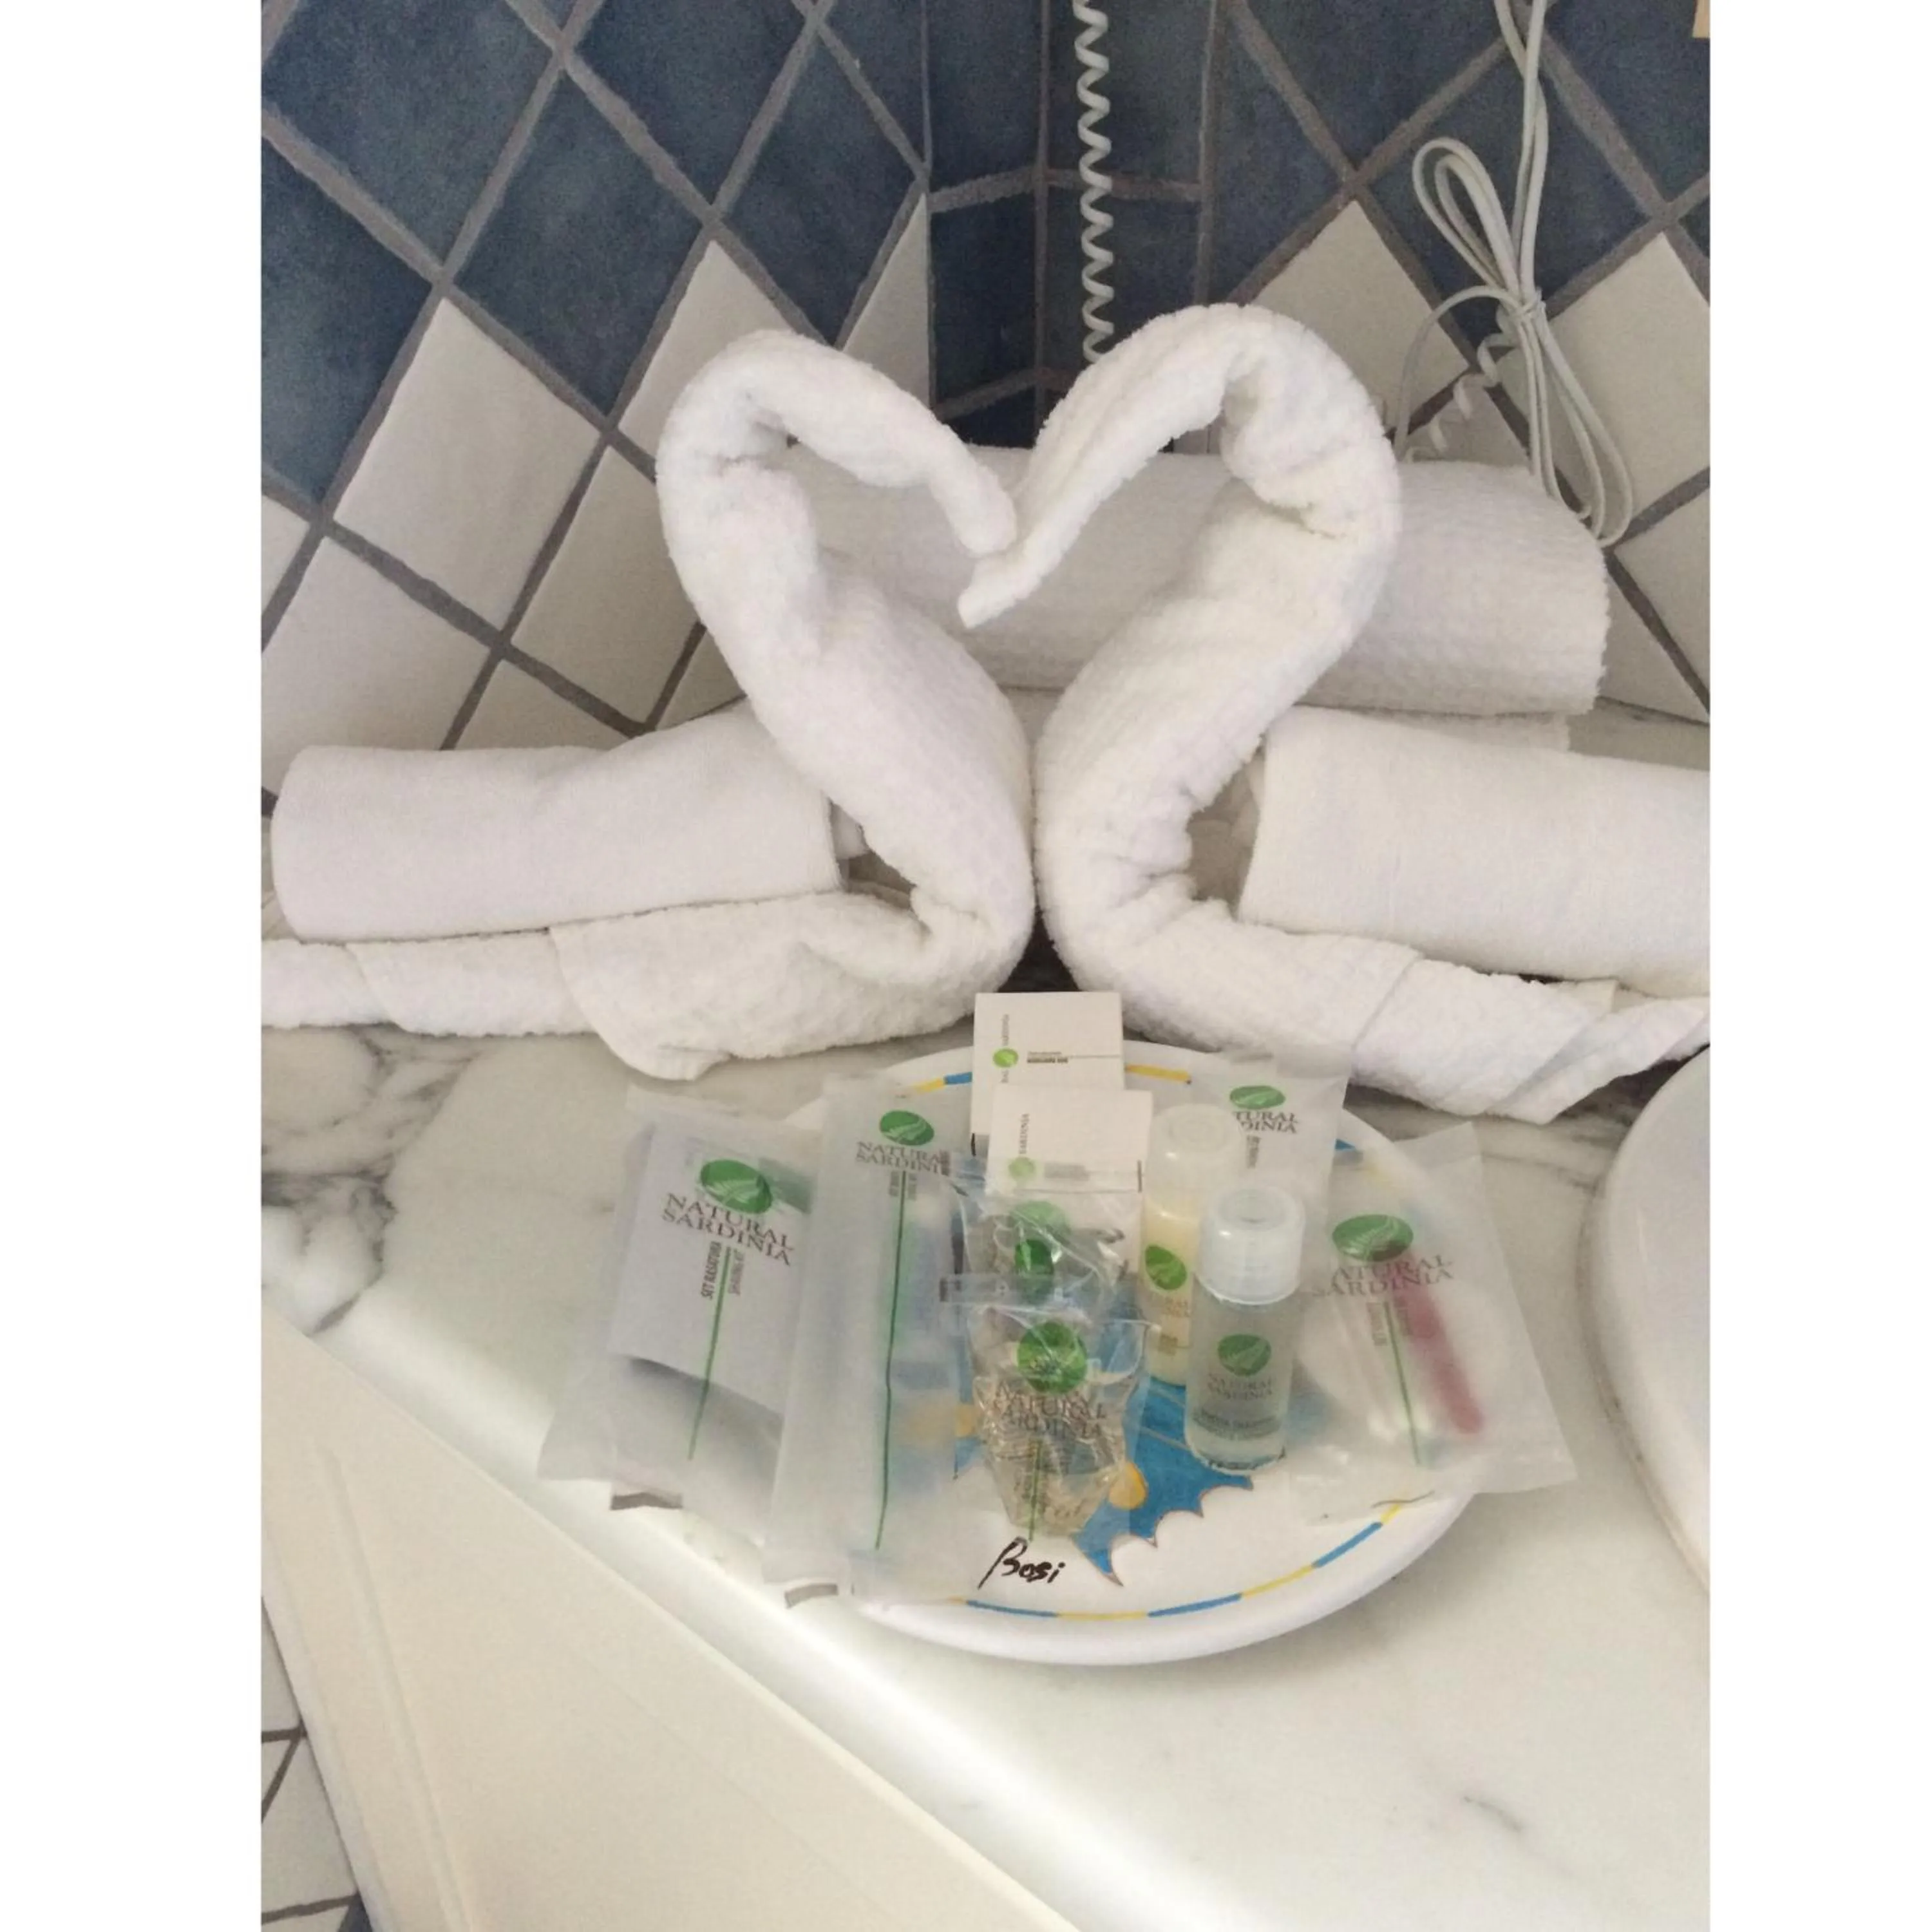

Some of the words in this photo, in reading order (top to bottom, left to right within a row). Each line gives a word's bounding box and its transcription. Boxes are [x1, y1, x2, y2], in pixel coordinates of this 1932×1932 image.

[1233, 1112, 1299, 1124] TURAL
[662, 1208, 791, 1266] SARDINIA
[667, 1192, 795, 1251] NATURAL
[976, 1535, 1066, 1591] Bosi
